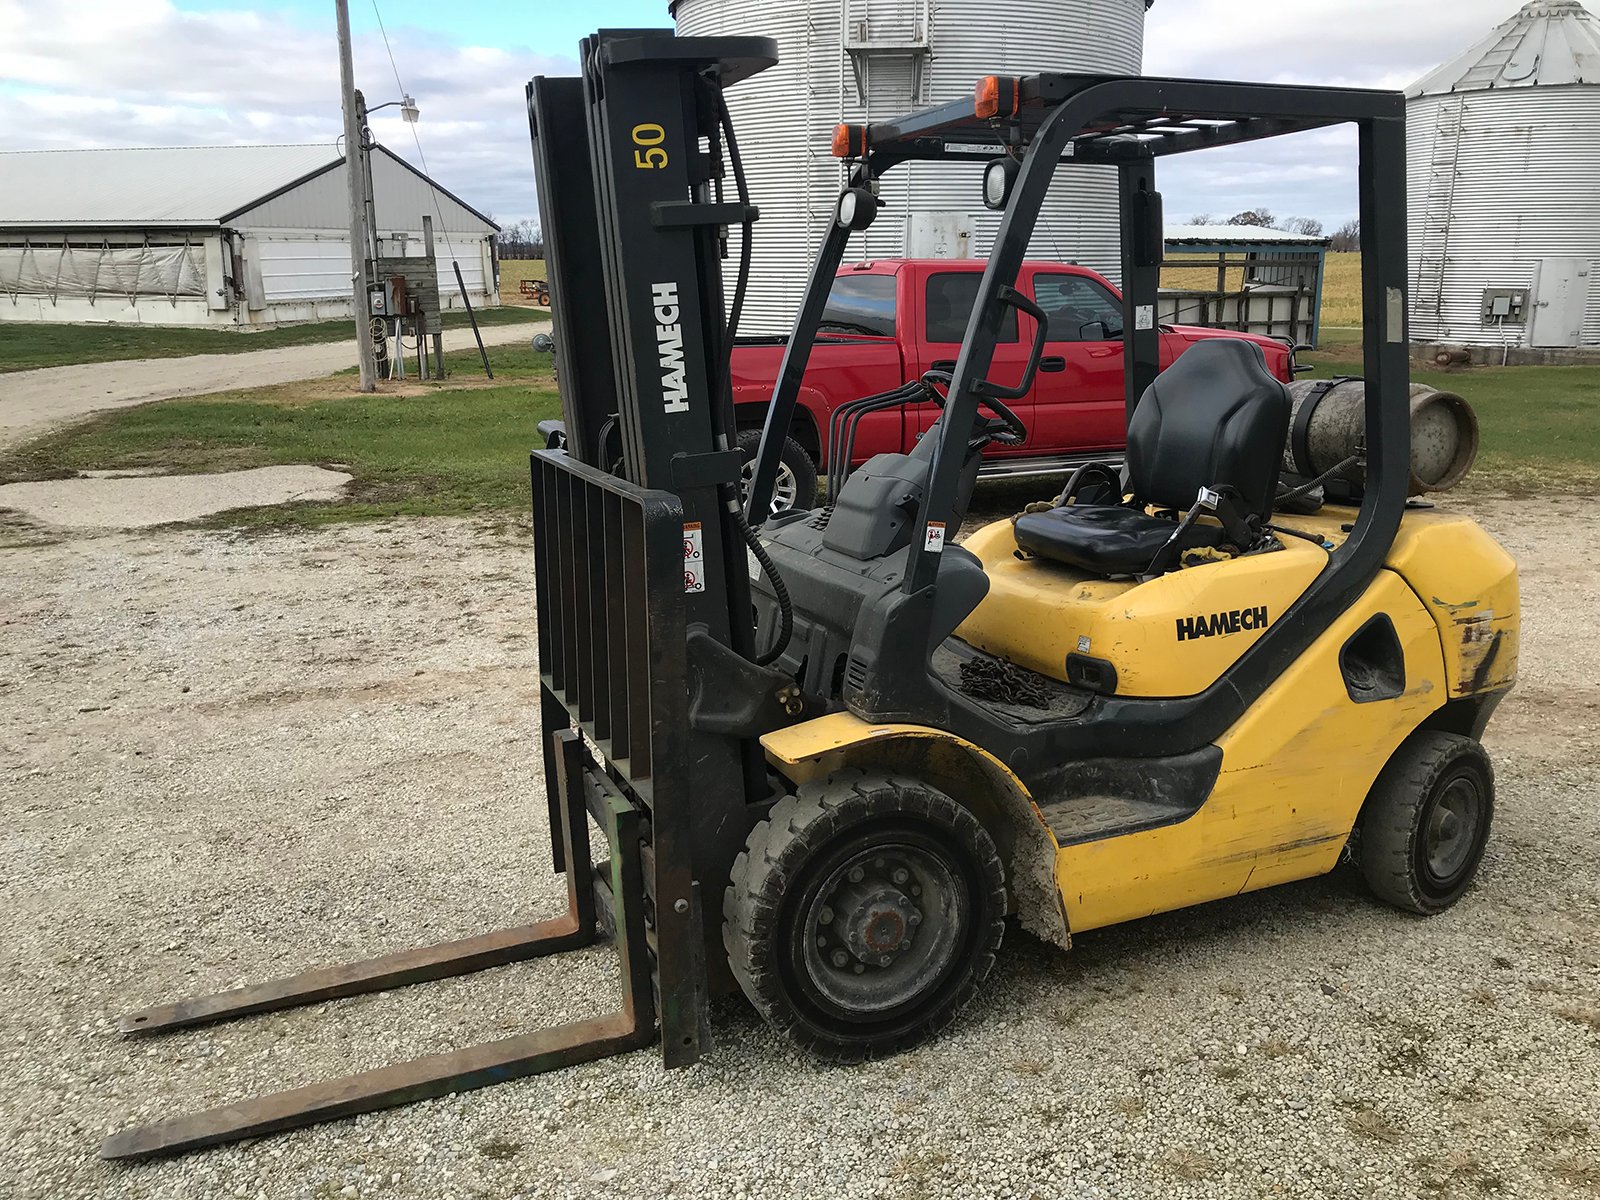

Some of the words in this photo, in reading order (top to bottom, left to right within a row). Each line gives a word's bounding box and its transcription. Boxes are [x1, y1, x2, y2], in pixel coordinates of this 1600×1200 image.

[632, 123, 669, 169] 50
[651, 282, 690, 414] HAMECH
[1176, 606, 1268, 641] HAMECH
